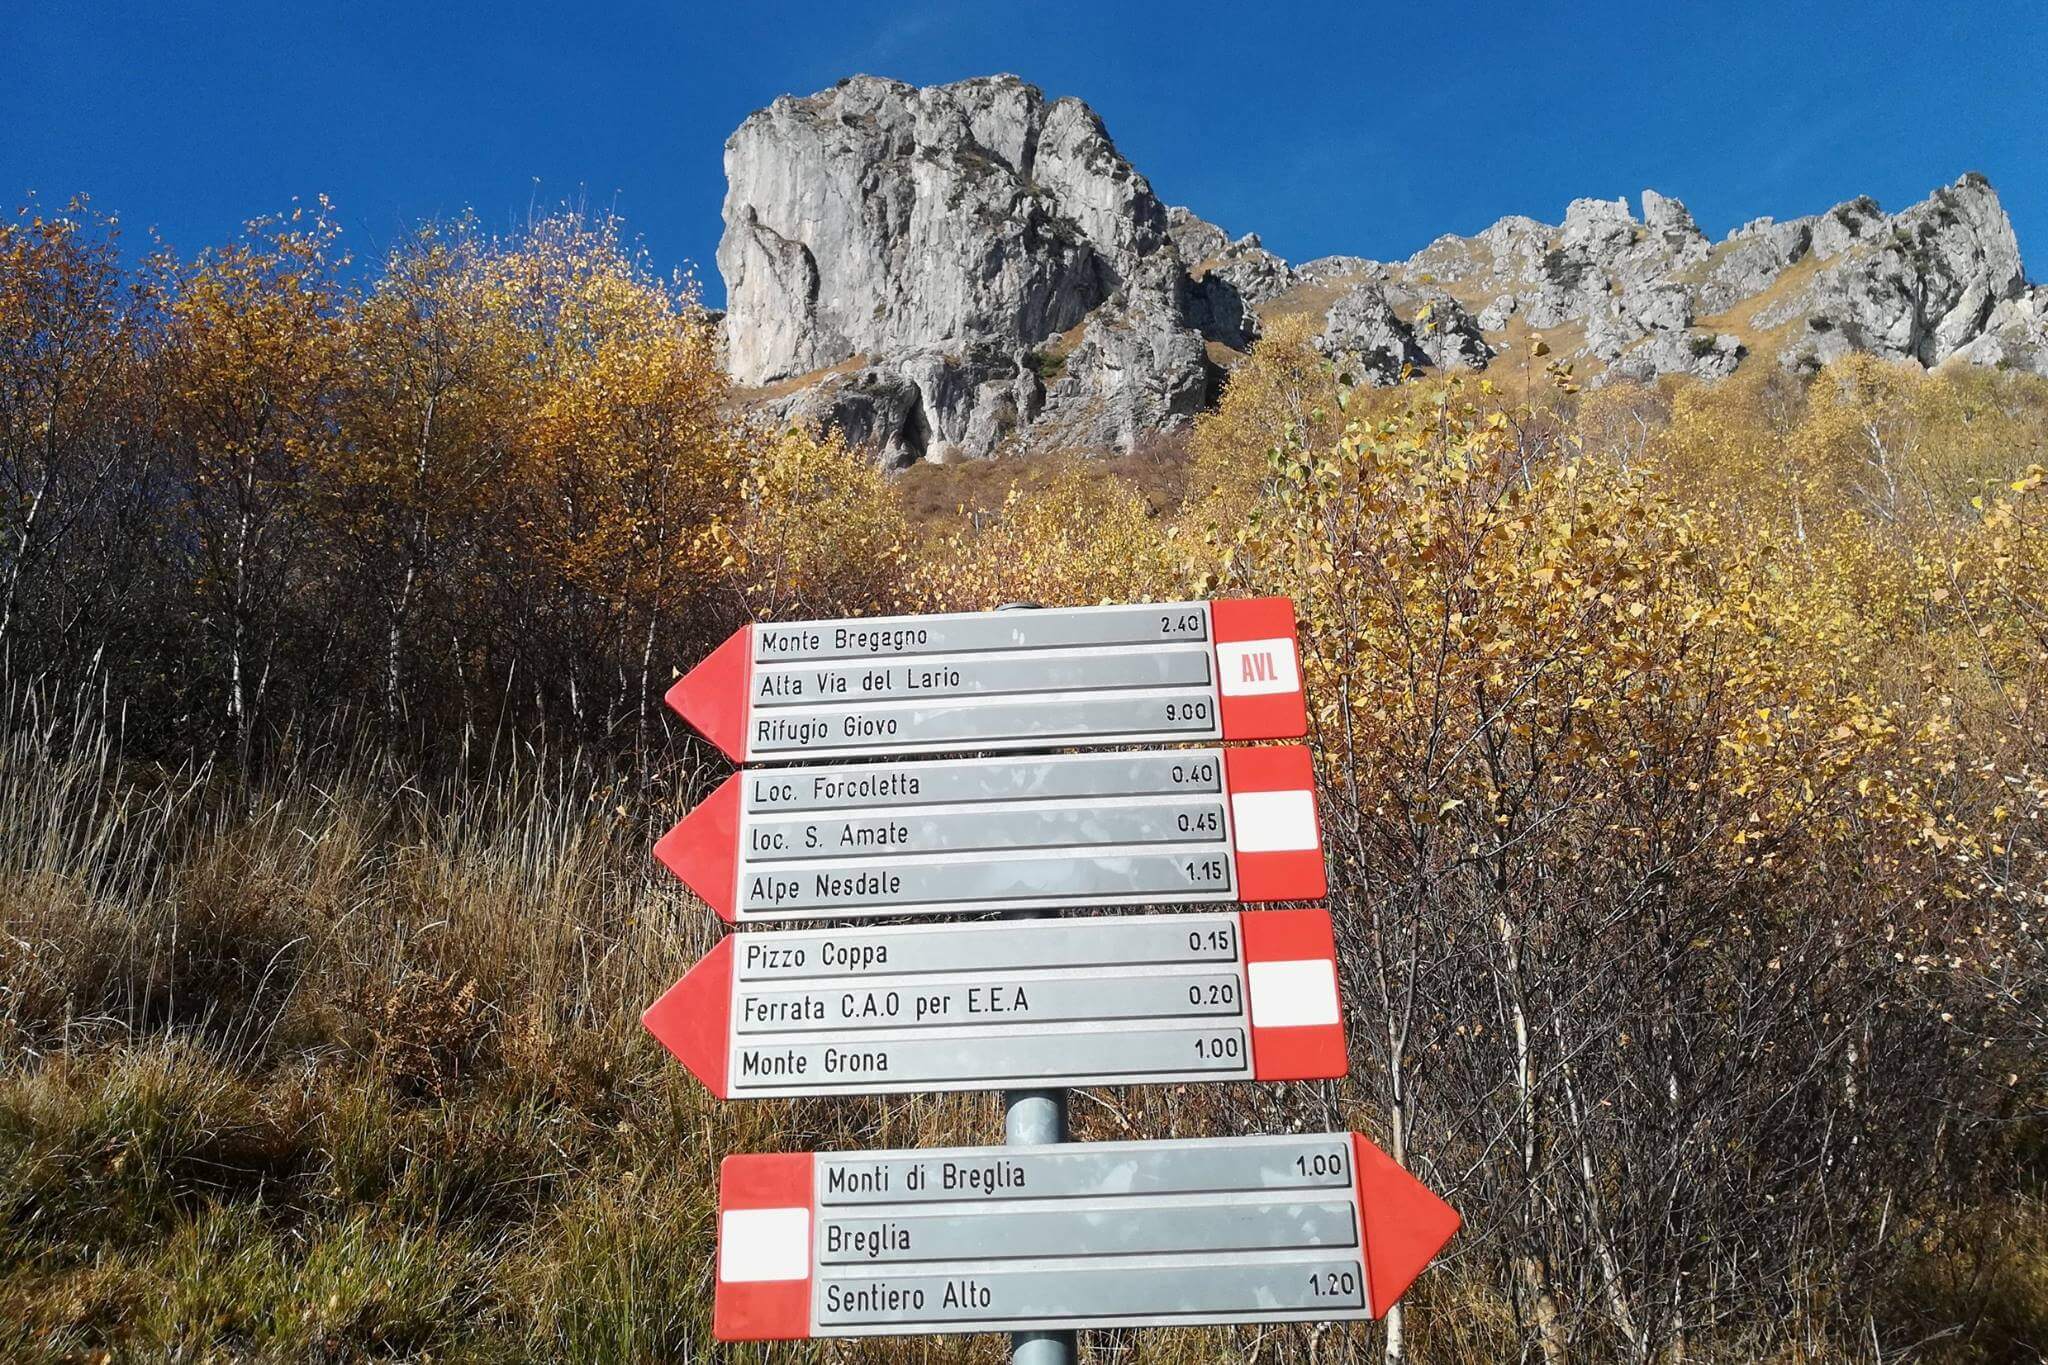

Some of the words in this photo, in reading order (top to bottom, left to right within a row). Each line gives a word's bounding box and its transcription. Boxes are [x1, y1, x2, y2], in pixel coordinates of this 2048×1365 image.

[762, 630, 820, 653] Monte
[835, 628, 927, 652] Bregagno
[1161, 615, 1199, 633] 2.40
[760, 675, 802, 697] Alta
[817, 672, 847, 694] Via
[862, 669, 892, 691] del
[907, 666, 960, 689] Lario
[1242, 652, 1278, 682] AVL
[758, 717, 828, 745] Rifugio
[844, 715, 897, 737] Giovo
[1166, 702, 1207, 721] 9.00
[755, 780, 797, 803] Loc.
[814, 773, 920, 800] Forcoletta
[1171, 764, 1213, 784] 0.40
[805, 825, 823, 849] S.
[839, 821, 908, 847] Amate
[1177, 812, 1218, 832] 0.45
[750, 876, 800, 905] Alpe
[816, 871, 901, 898] Nesdale
[1185, 860, 1222, 881] 1.15
[747, 945, 805, 969] Pizzo
[822, 942, 887, 971] Coppa
[1189, 930, 1229, 951] 0.15
[745, 995, 825, 1022] Ferrata
[841, 991, 899, 1018] C.A.O
[916, 996, 951, 1021] per
[968, 986, 1029, 1013] E.E.A
[1189, 984, 1234, 1005] 0.20
[743, 1050, 807, 1076] Monte
[824, 1048, 888, 1073] Grona
[1194, 1037, 1238, 1059] 1.00
[829, 1165, 889, 1194] Monti
[906, 1164, 925, 1191] di
[943, 1160, 1026, 1195] Breglia
[1296, 1154, 1342, 1177] 1.00
[828, 1223, 911, 1258] Breglia
[827, 1283, 924, 1313] Sentiero
[942, 1280, 991, 1309] Alto
[1309, 1271, 1355, 1297] 1.20
